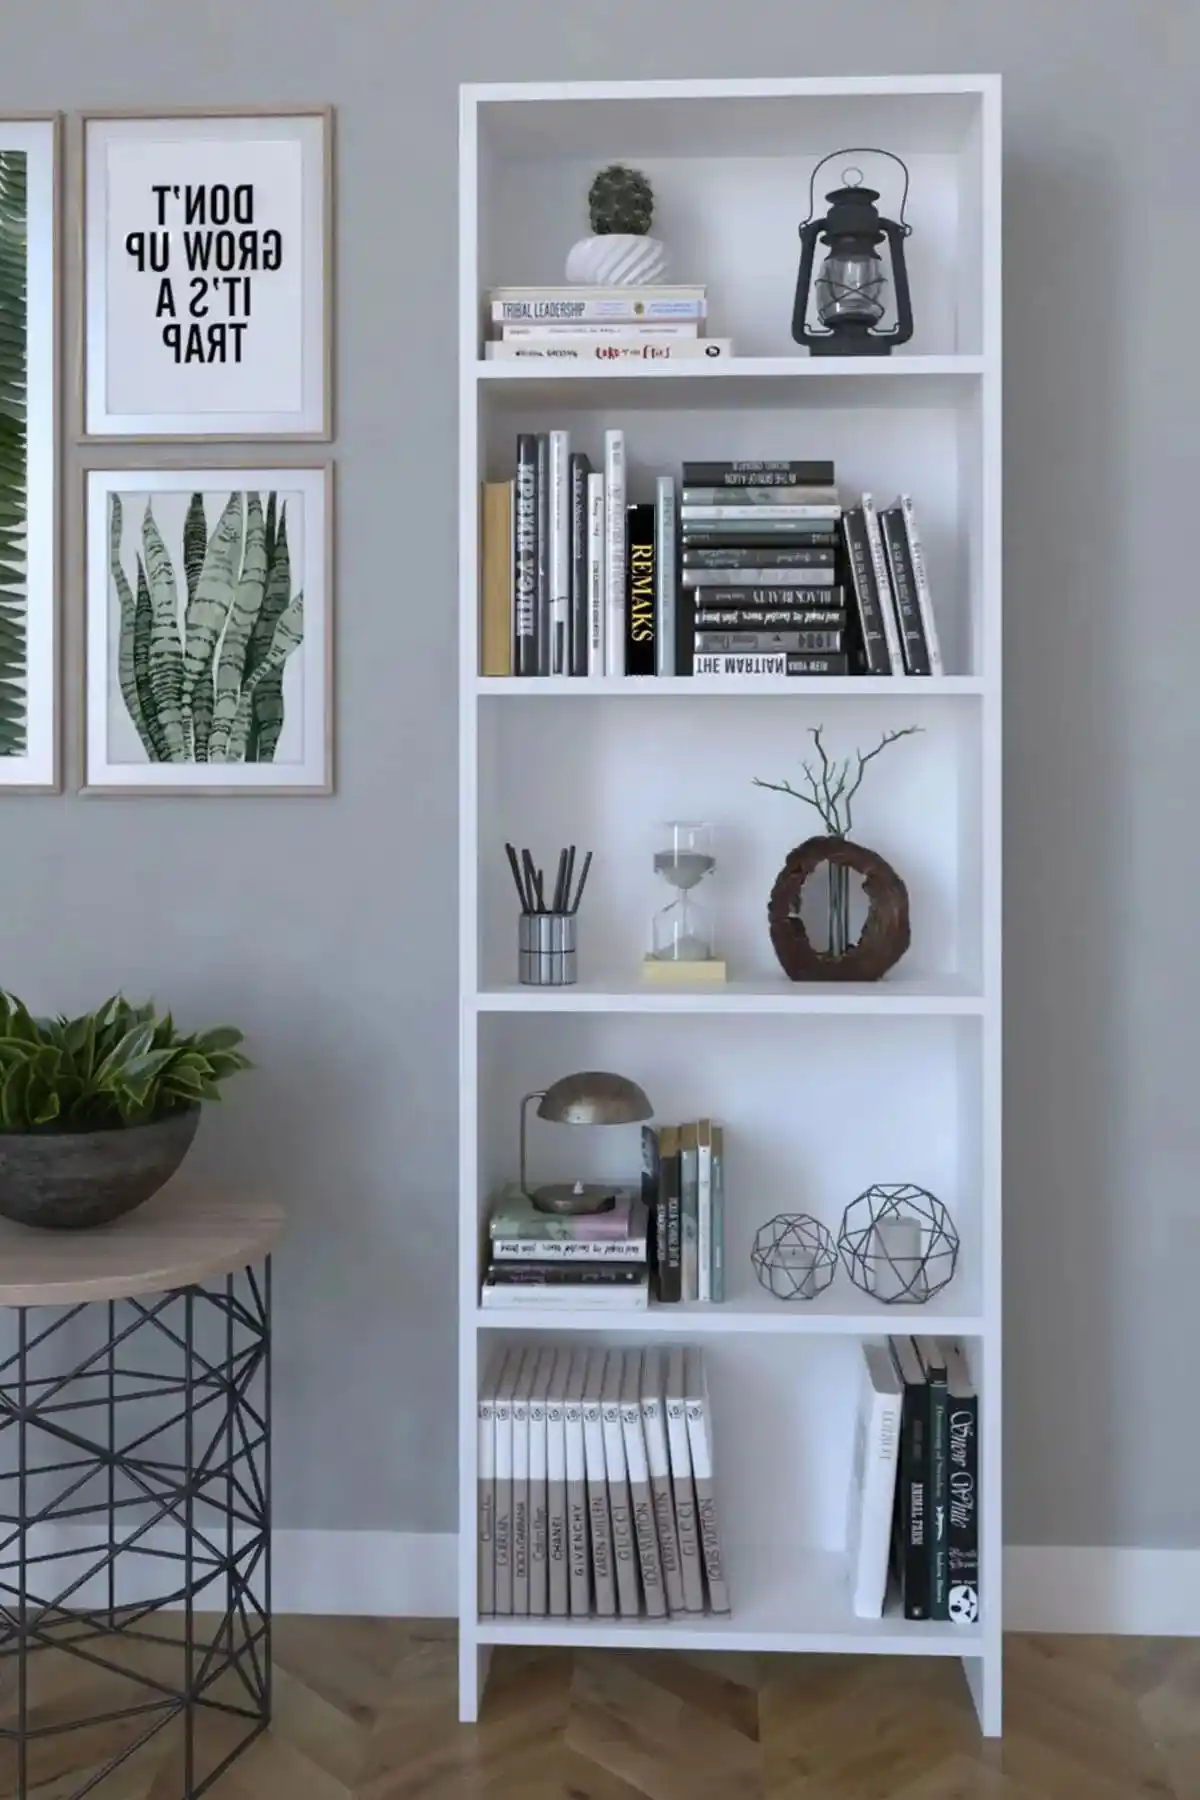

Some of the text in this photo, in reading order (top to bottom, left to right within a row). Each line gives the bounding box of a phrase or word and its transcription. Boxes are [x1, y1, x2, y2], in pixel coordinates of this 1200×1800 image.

[502, 302, 532, 318] TRIBAL
[534, 302, 586, 318] LEADERSHIP
[515, 463, 535, 637] ИРВИН УЭЛШ
[631, 543, 654, 642] REMAKS
[949, 1410, 975, 1467] Snow
[911, 1482, 924, 1517] ANIMAL
[949, 1470, 975, 1529] White
[551, 1515, 563, 1561] CHANEL
[572, 1504, 584, 1577] GIVENCHY
[614, 1505, 630, 1562] GUCCI
[678, 1500, 695, 1557] GUCCI
